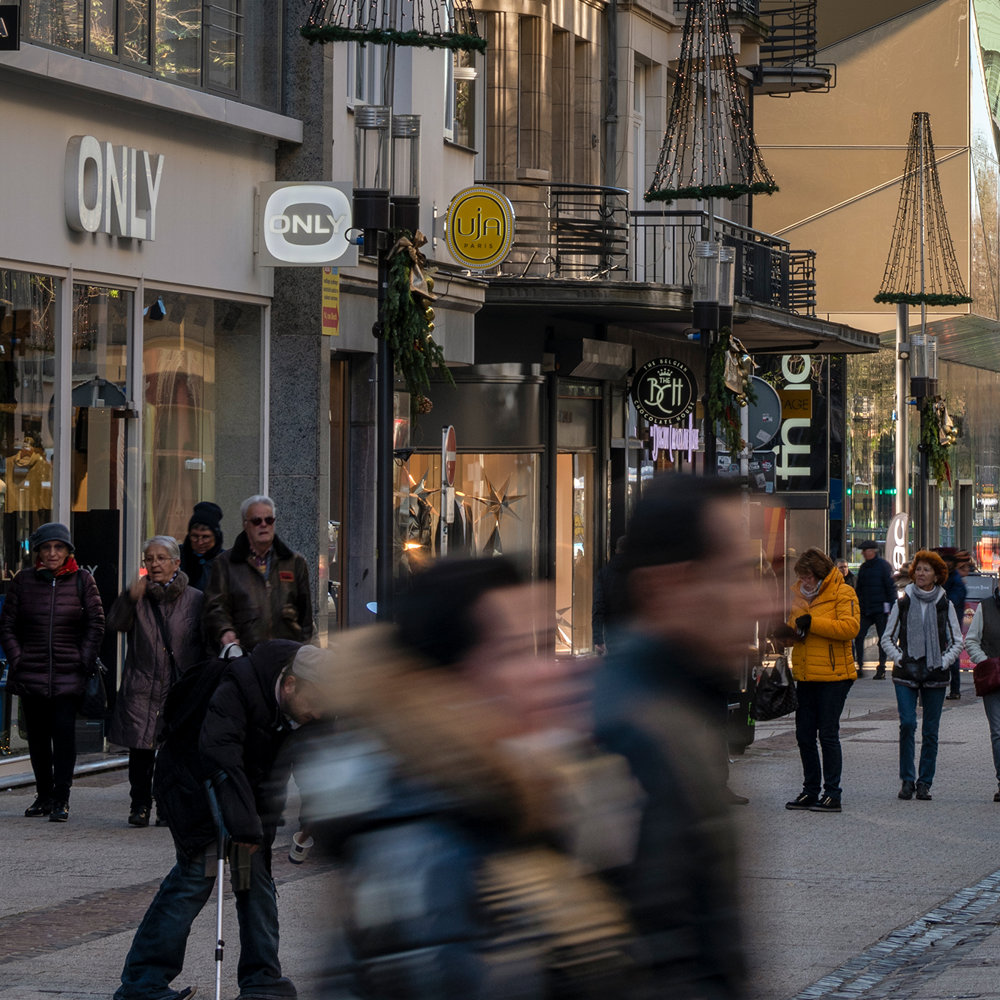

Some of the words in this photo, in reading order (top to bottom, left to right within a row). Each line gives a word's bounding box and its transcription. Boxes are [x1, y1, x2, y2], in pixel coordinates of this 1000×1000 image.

[66, 135, 165, 241] ONLY
[269, 214, 347, 234] ONLY
[643, 361, 656, 370] THE
[660, 358, 688, 372] BELGIAN
[644, 378, 683, 414] BCH
[781, 400, 809, 411] AGE
[633, 400, 672, 424] CHOCOLATE
[676, 401, 695, 421] HOUSE
[772, 354, 811, 480] fnc
